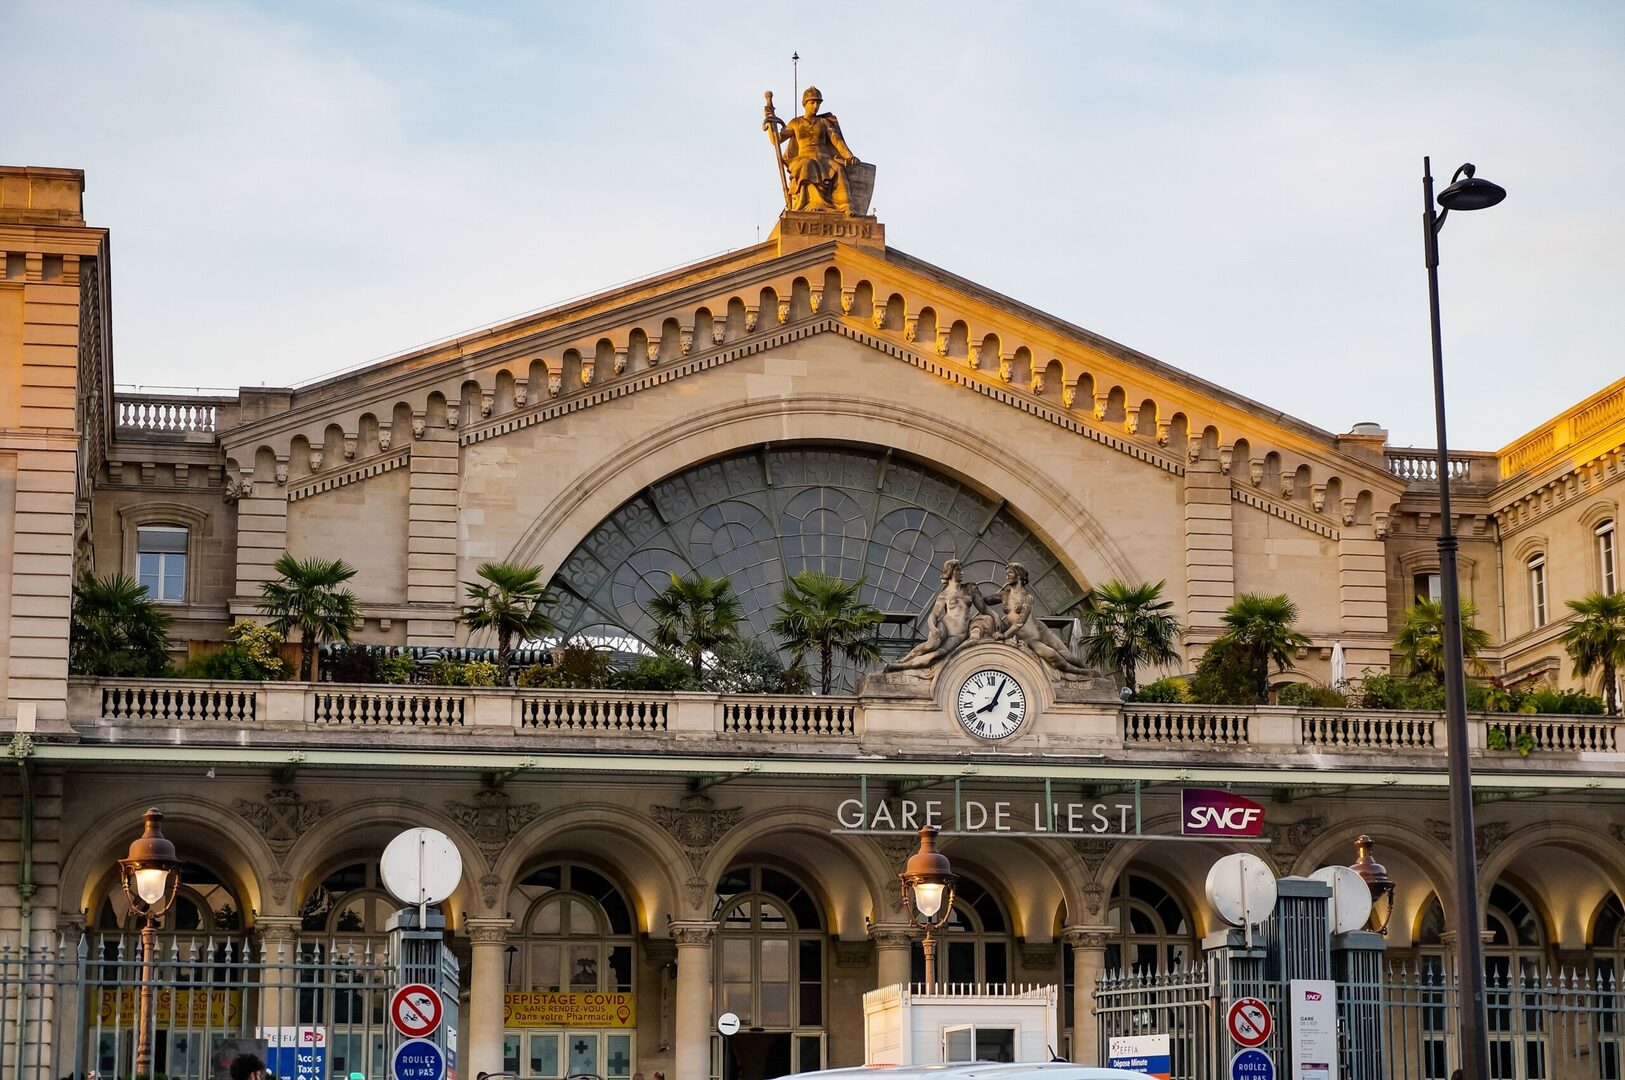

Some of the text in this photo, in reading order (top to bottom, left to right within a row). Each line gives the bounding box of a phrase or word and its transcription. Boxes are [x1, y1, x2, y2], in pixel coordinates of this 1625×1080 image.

[795, 221, 873, 239] VERDUN
[837, 799, 1132, 833] GARE DE L'EST
[1187, 806, 1261, 830] SNCF
[504, 995, 625, 1005] DEPISTAGE COVID
[524, 1005, 606, 1013] SANS RENDEZ-VOUS
[515, 1012, 614, 1021] Dans votre Pharmacie
[1120, 1046, 1138, 1055] EFFIA
[402, 1056, 435, 1064] ROULEZ
[298, 1065, 320, 1074] Taxs
[1238, 1063, 1267, 1072] ROULEZ
[403, 1068, 434, 1077] AU PAS
